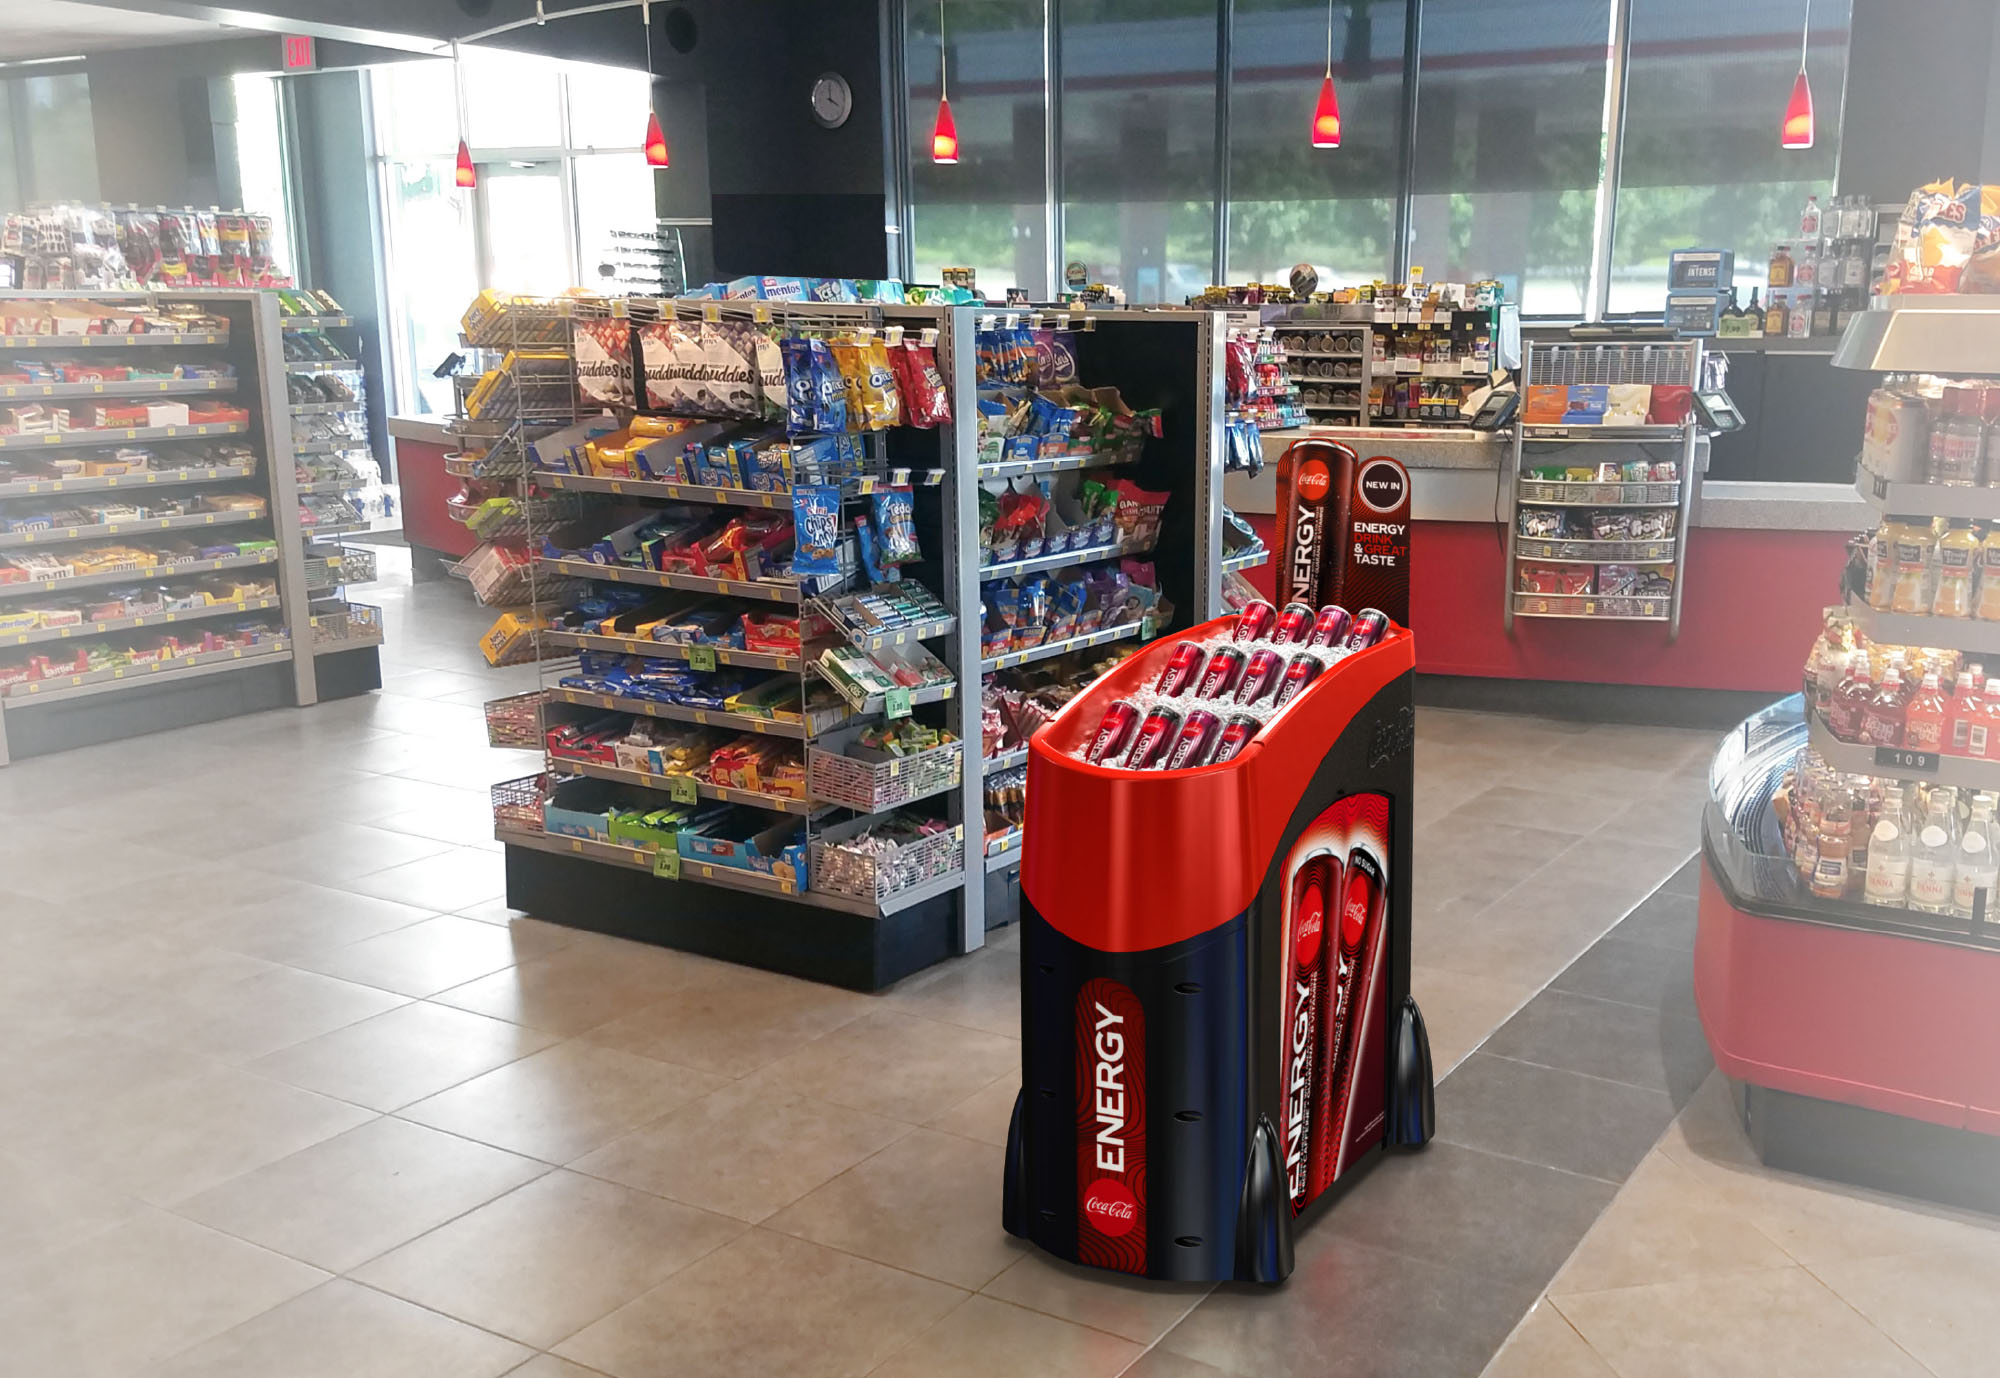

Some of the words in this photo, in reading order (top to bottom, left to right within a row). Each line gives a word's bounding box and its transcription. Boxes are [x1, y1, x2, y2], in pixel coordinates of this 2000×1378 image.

[287, 36, 311, 66] EXIT
[1687, 267, 1717, 277] INTENSE
[766, 284, 801, 298] mentos
[702, 363, 754, 385] buddies
[1298, 473, 1328, 487] Coca-Cola
[1366, 481, 1389, 490] NEW
[1390, 482, 1401, 491] IN
[805, 515, 833, 535] Chips
[1353, 522, 1406, 535] ENERGY
[1354, 533, 1393, 545] DRINK
[1353, 543, 1364, 553] &
[1363, 545, 1408, 557] GREAT
[1354, 554, 1396, 566] TASTE
[1894, 753, 1926, 767] 109
[1353, 855, 1362, 866] NO
[1361, 858, 1376, 876] SUGAR
[1297, 911, 1322, 943] Coca-Cola
[1095, 1001, 1125, 1173] ENERGY
[1286, 980, 1310, 1200] ENERGY
[1086, 1196, 1136, 1220] Coca-Cola
